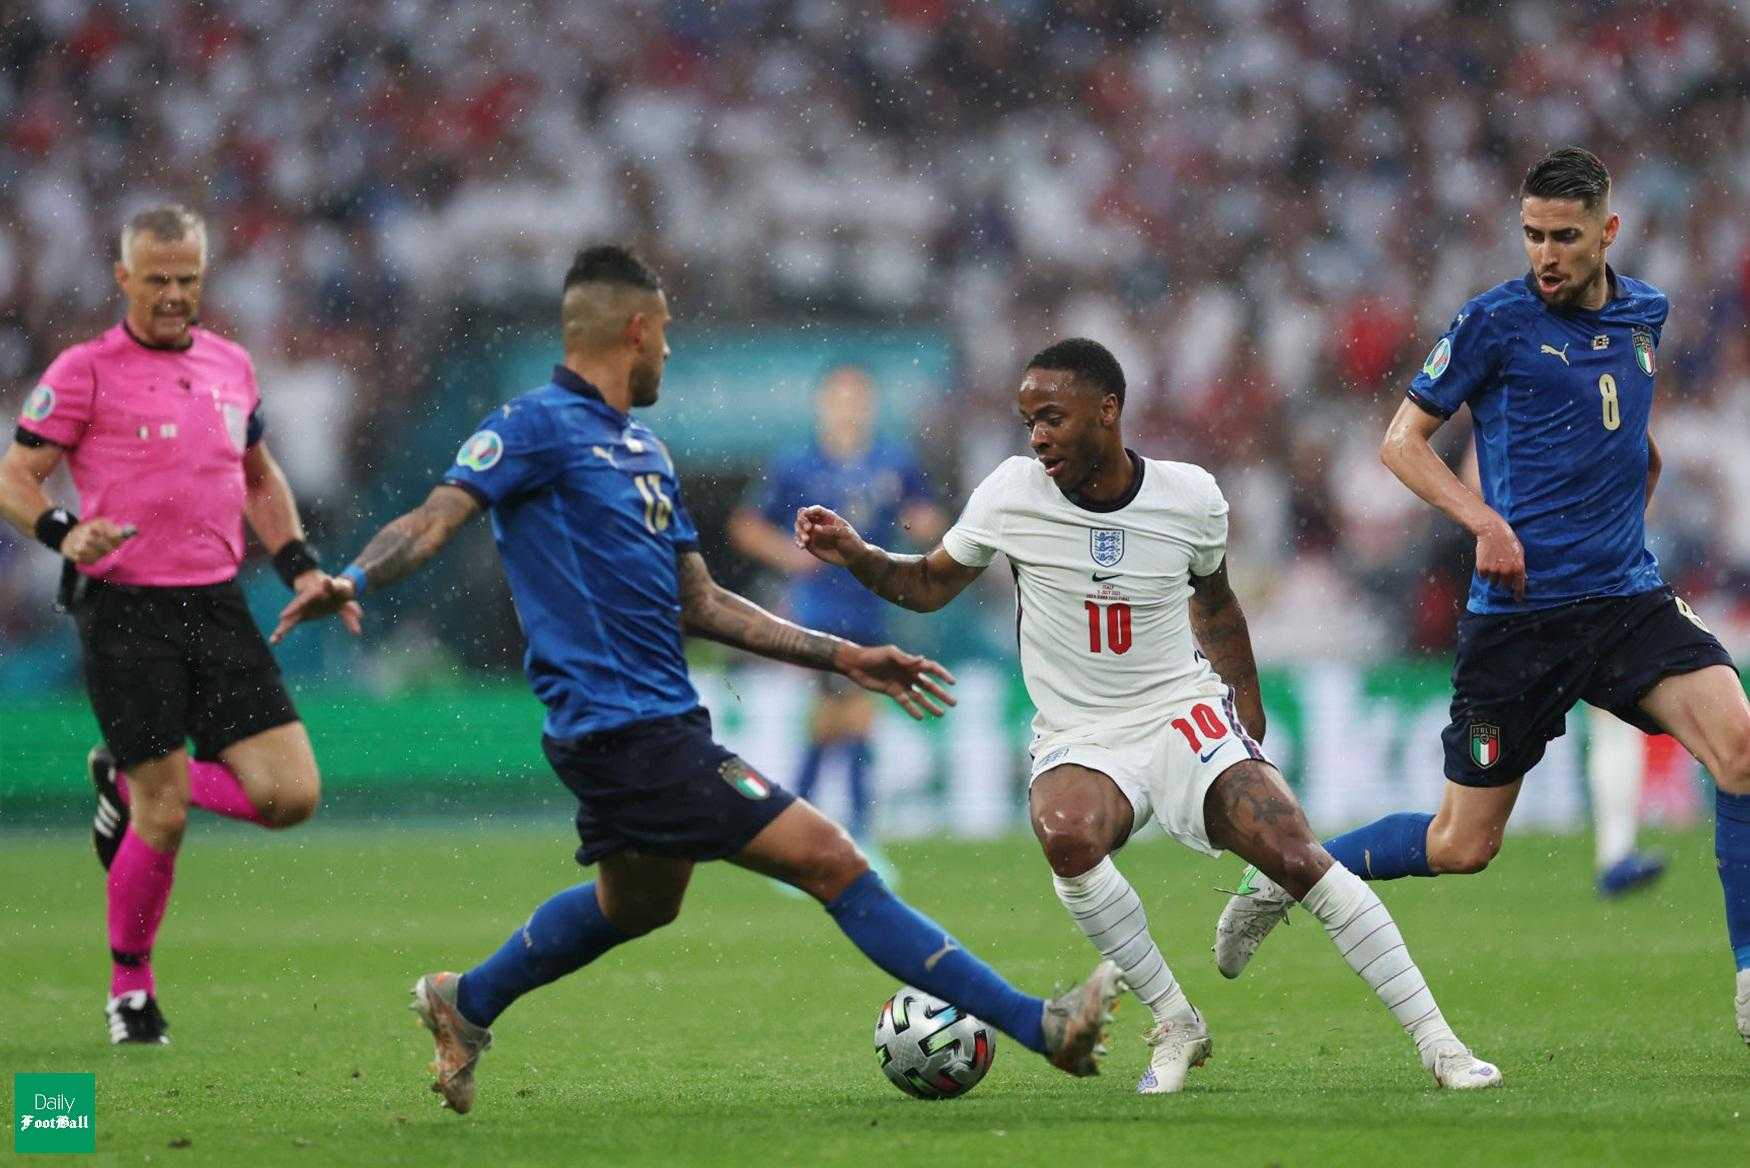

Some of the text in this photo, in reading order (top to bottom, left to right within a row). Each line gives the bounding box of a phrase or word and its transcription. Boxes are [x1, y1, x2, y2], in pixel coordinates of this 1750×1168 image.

[1598, 373, 1621, 431] 8
[1084, 600, 1132, 655] 10
[1171, 703, 1228, 754] 10
